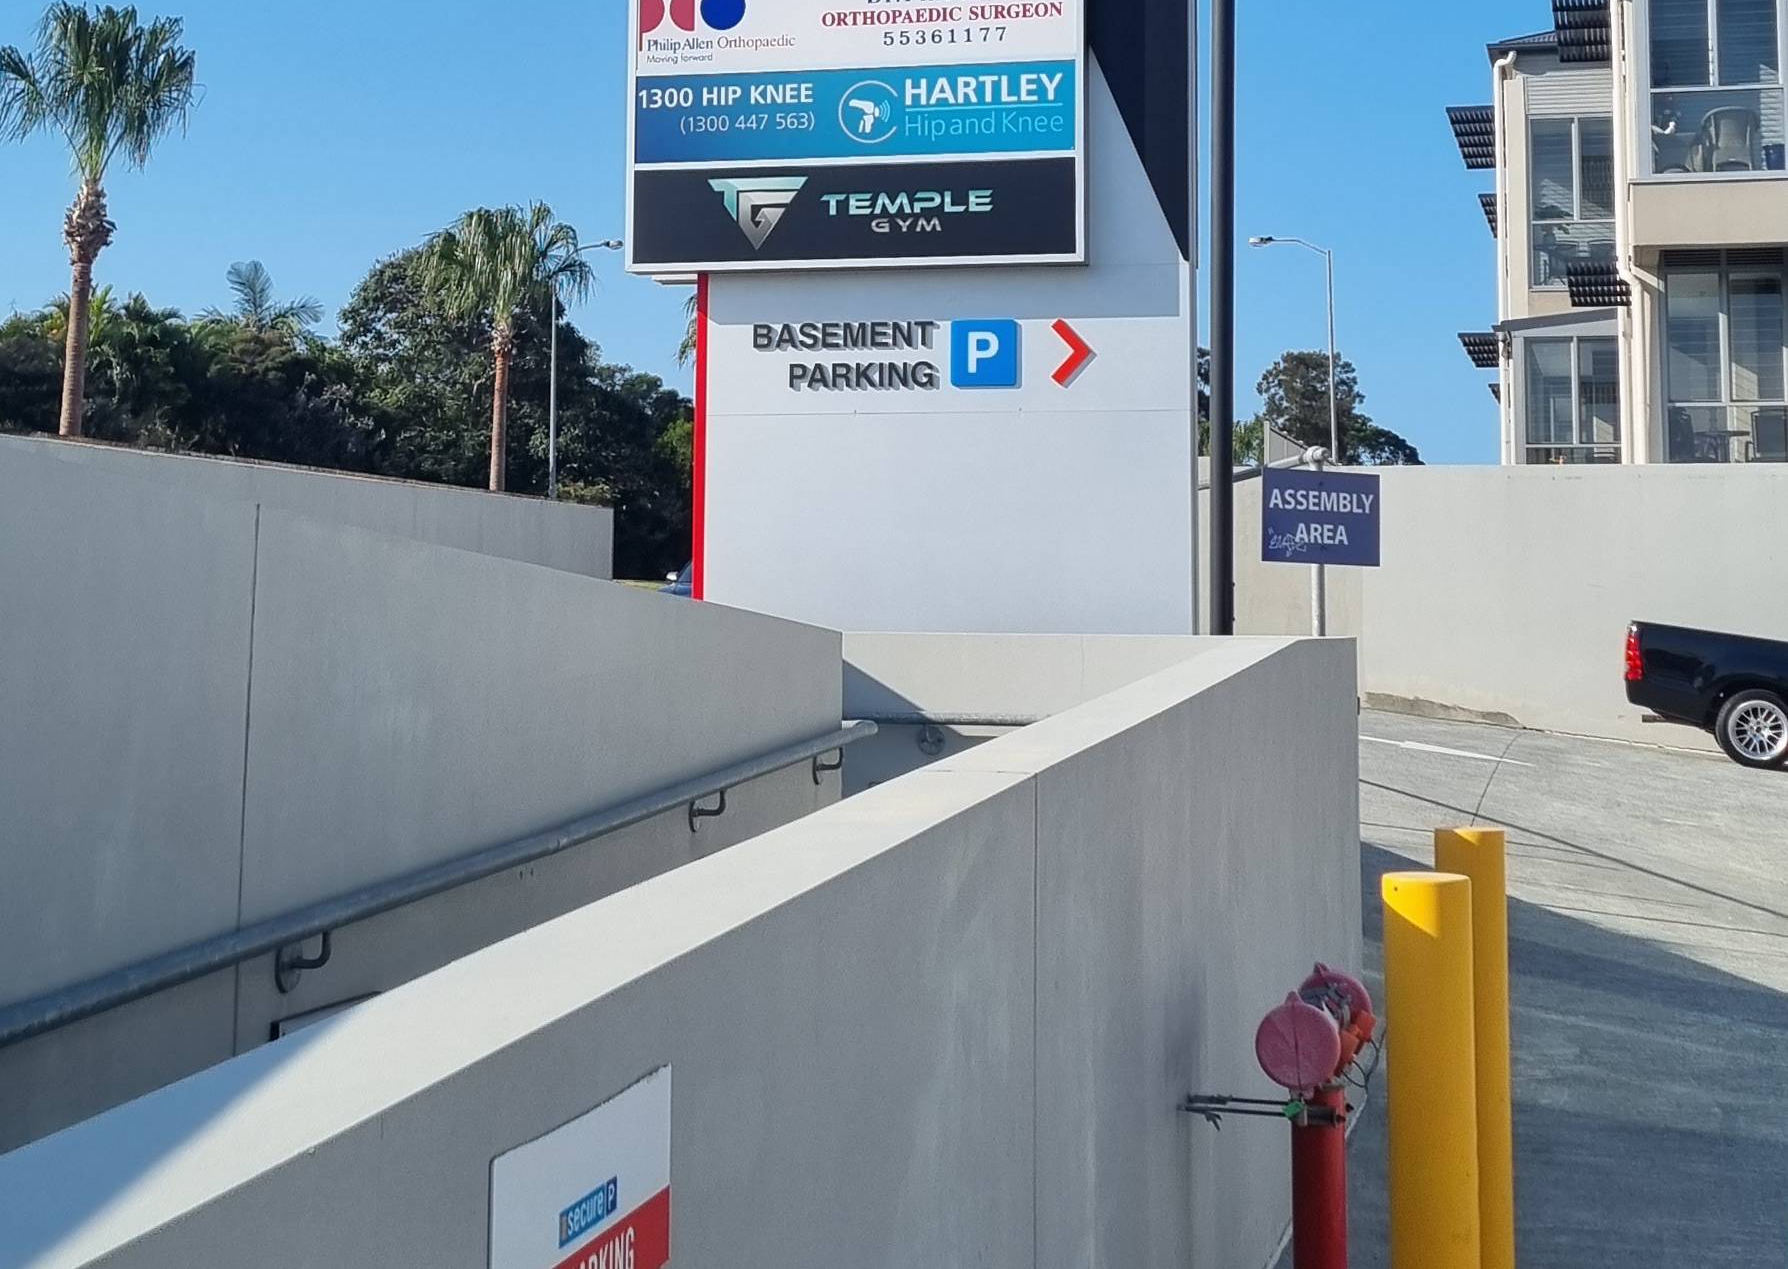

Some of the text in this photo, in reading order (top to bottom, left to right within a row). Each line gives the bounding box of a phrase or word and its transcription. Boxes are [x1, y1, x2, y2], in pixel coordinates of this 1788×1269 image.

[821, 1, 1063, 27] ORTHOPAEDIC SURGEON
[647, 34, 796, 54] Philip Allen Orthopaedic
[883, 27, 1006, 46] 55361177
[647, 54, 678, 65] Moving
[638, 83, 813, 109] 1300 HIP KNEE
[904, 73, 1063, 106] HARTLEY
[680, 111, 815, 135] (1300 447 563)
[905, 110, 1064, 141] Hip and Knee
[820, 189, 993, 216] TEMPLE
[871, 217, 942, 233] GYM
[752, 321, 999, 374] BASEMENT P
[788, 361, 937, 390] PARKING
[1269, 488, 1374, 514] ASSEMBLY
[1294, 522, 1349, 545] AREA
[568, 1191, 604, 1237] secure
